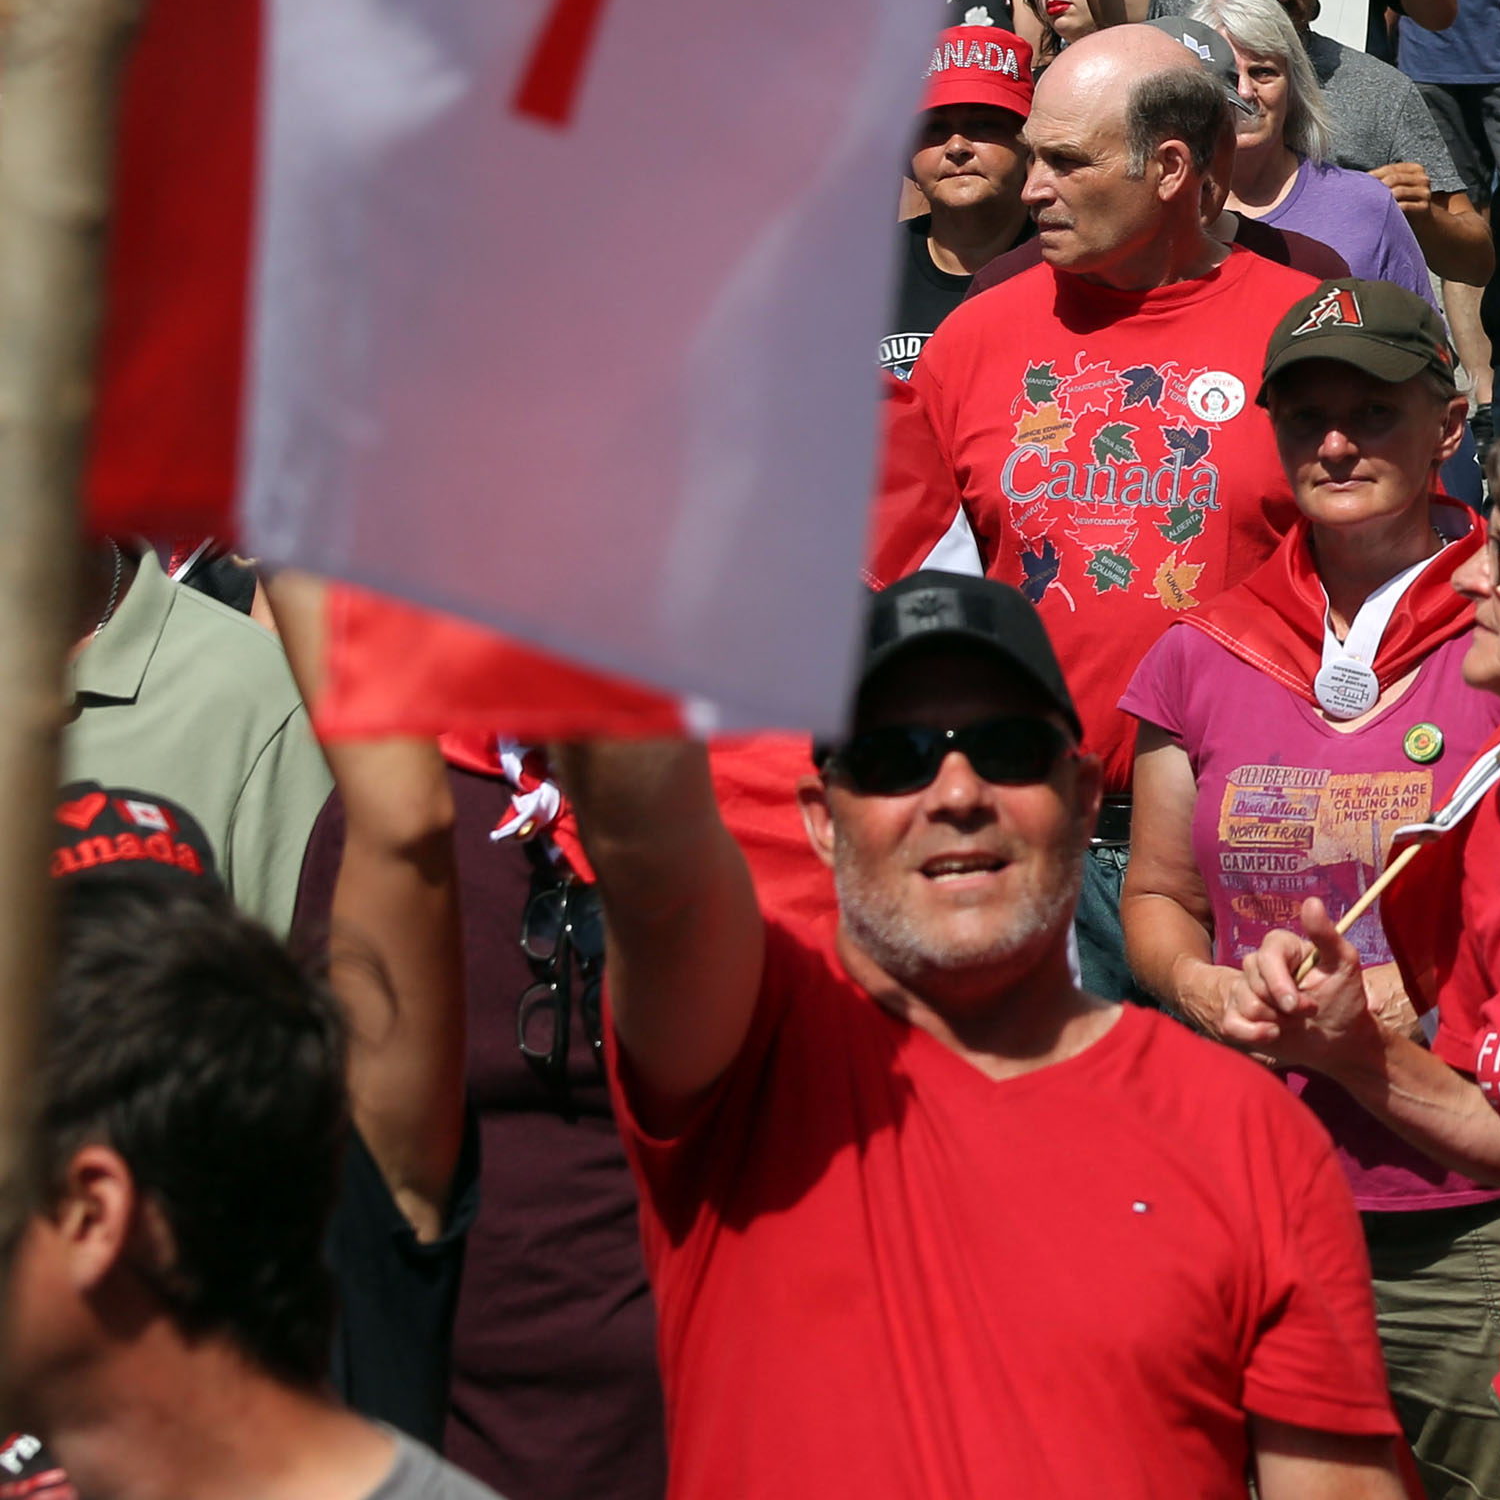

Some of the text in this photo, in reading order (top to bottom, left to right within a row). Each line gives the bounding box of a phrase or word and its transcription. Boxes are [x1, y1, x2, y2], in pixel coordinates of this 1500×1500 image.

[922, 39, 1020, 81] ANADA
[1031, 432, 1057, 443] ISLAND
[1001, 445, 1222, 510] Canada
[1076, 517, 1132, 526] NEWFOUNDLAND
[1168, 513, 1201, 539] ALBERTA
[1091, 561, 1126, 587] COLUMBIA
[1101, 554, 1128, 577] BRITISH
[1163, 570, 1184, 604] YUKON
[1329, 783, 1427, 799] THE TRAILS ARE
[1334, 796, 1419, 810] CALLING AND
[1335, 811, 1341, 823] I
[1344, 810, 1378, 821] MUST
[1229, 825, 1309, 839] NORTH TRAIL
[1223, 853, 1299, 871] CAMPING
